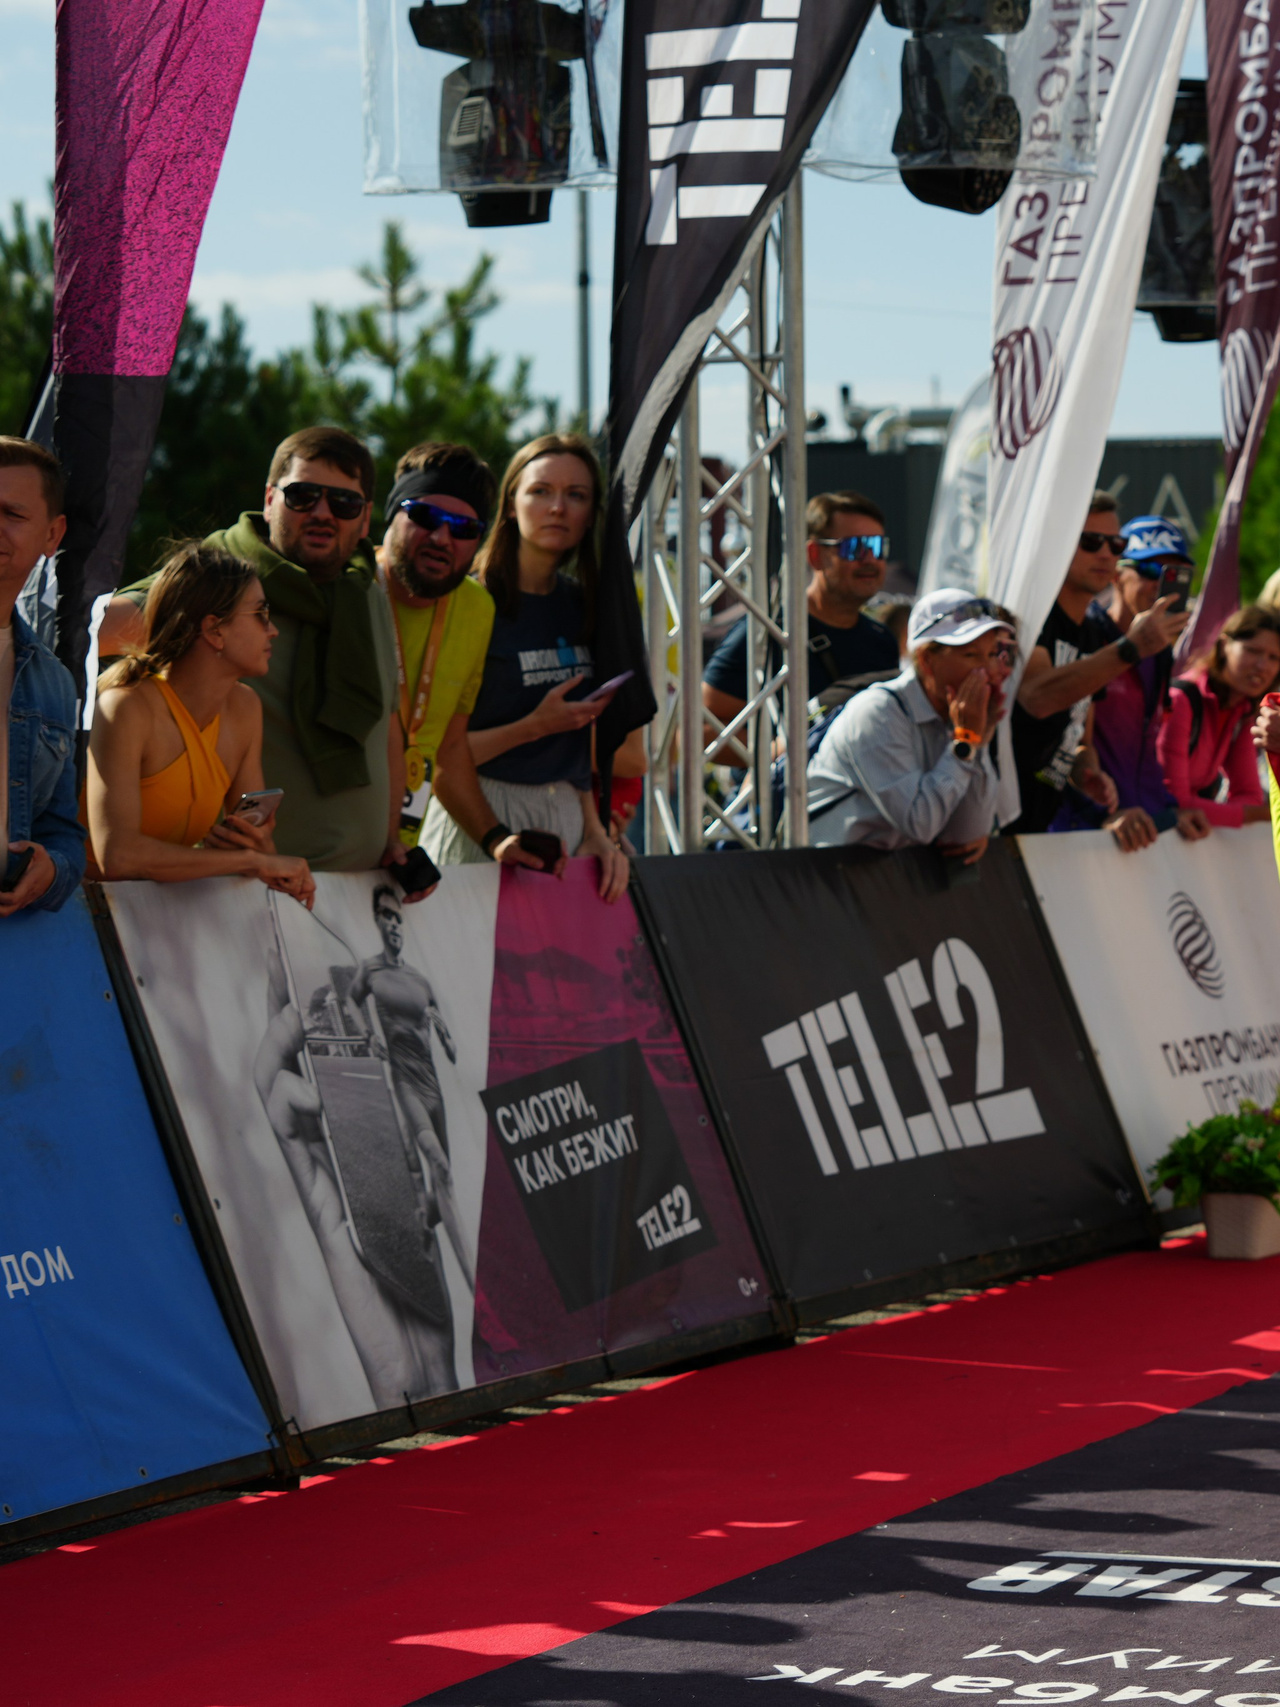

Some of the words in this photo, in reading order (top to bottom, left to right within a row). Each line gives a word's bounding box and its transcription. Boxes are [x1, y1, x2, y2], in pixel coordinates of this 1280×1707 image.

[761, 937, 1047, 1176] TELE2
[495, 1080, 598, 1145] СМОТРИ,
[513, 1144, 567, 1194] КАК
[559, 1113, 640, 1176] БЕЖИТ
[636, 1184, 702, 1251] TELE2
[0, 1245, 75, 1299] ДОМ
[738, 1276, 759, 1297] 0+
